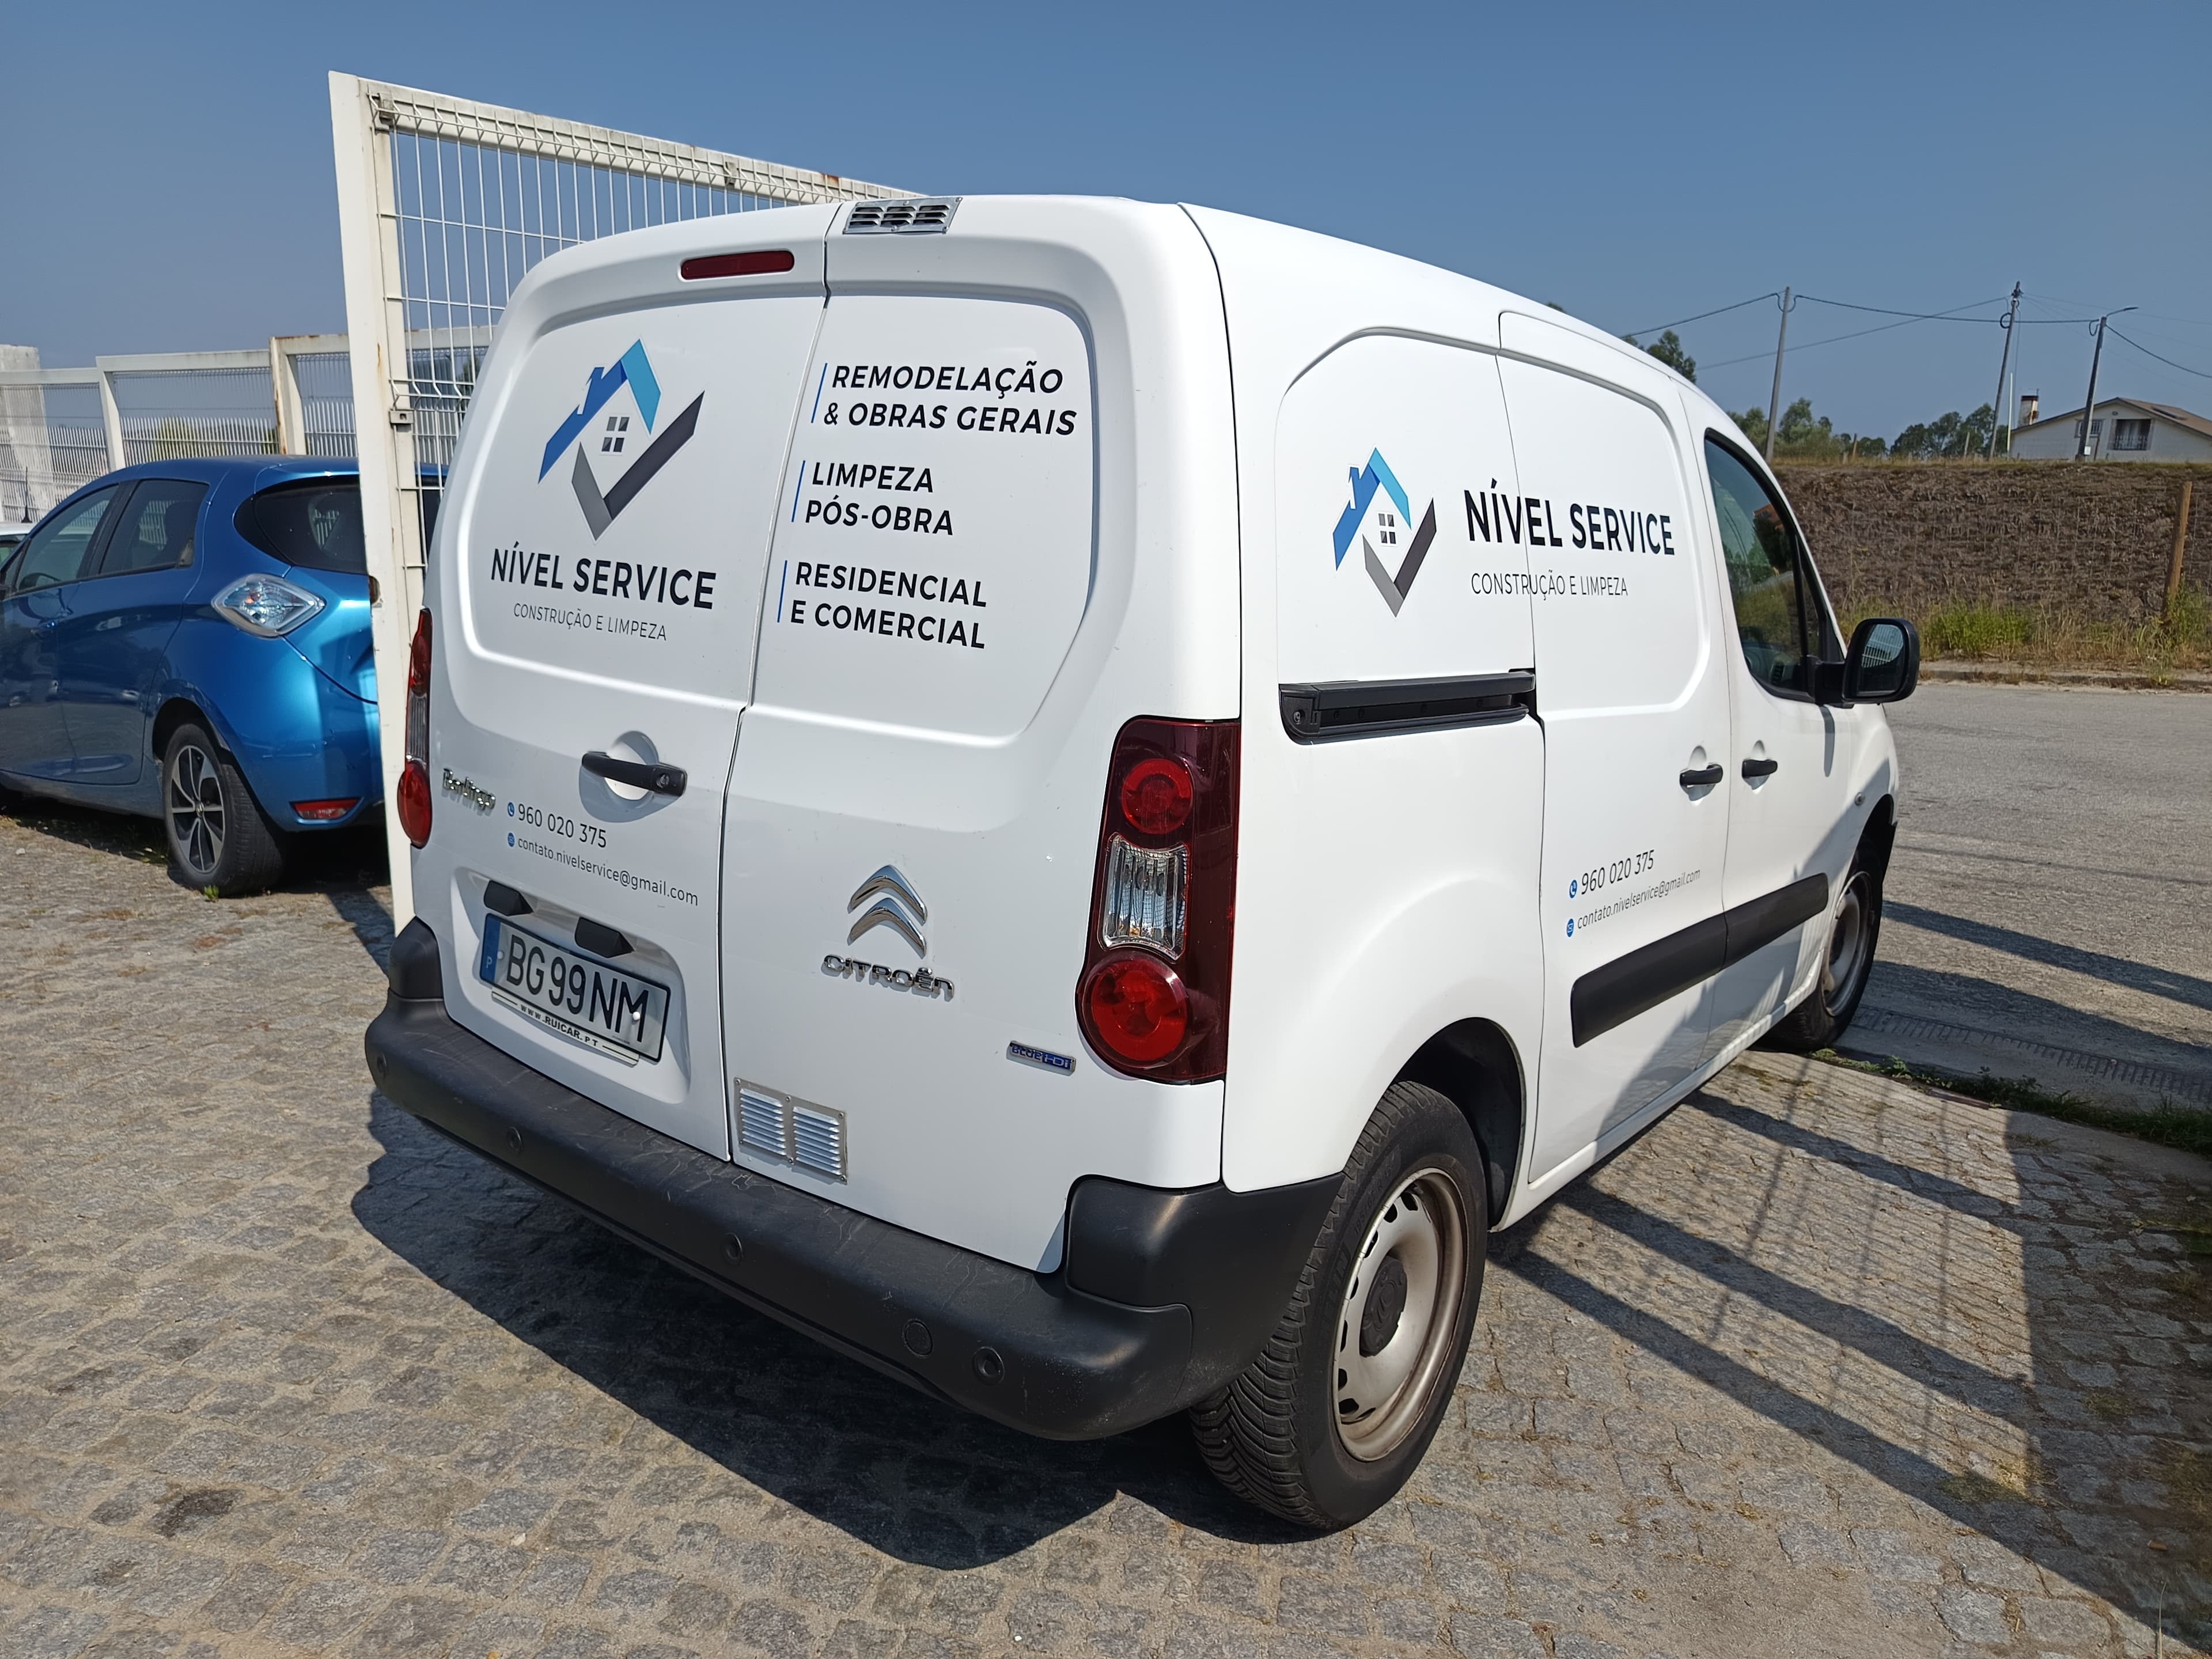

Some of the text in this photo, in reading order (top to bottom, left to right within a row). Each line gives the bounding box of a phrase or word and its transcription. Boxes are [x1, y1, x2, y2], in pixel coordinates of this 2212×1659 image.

[832, 361, 1063, 399] REMODELAÇÃO
[824, 403, 1077, 435] & OBRAS GERAIS
[812, 463, 934, 493] LIMPEZA
[805, 495, 953, 536] PÓS-OBRA
[1464, 478, 1675, 555] NÍVEL SERVICE
[491, 541, 717, 610] NÍVEL SERVICE
[796, 562, 987, 608] RESIDENCIAL
[1471, 569, 1628, 601] CONSTRUÇÃO E LIMPEZA
[513, 603, 667, 641] CONSTRUÇÃO E LIMPEZA
[791, 600, 986, 649] E COMERCIAL
[518, 804, 607, 849] 960 020 375
[518, 835, 699, 907] contato.nivelservice@gmail.com
[1581, 849, 1654, 895] 960 020 375
[1577, 869, 1701, 930] contato.nivelservice@gmail.com
